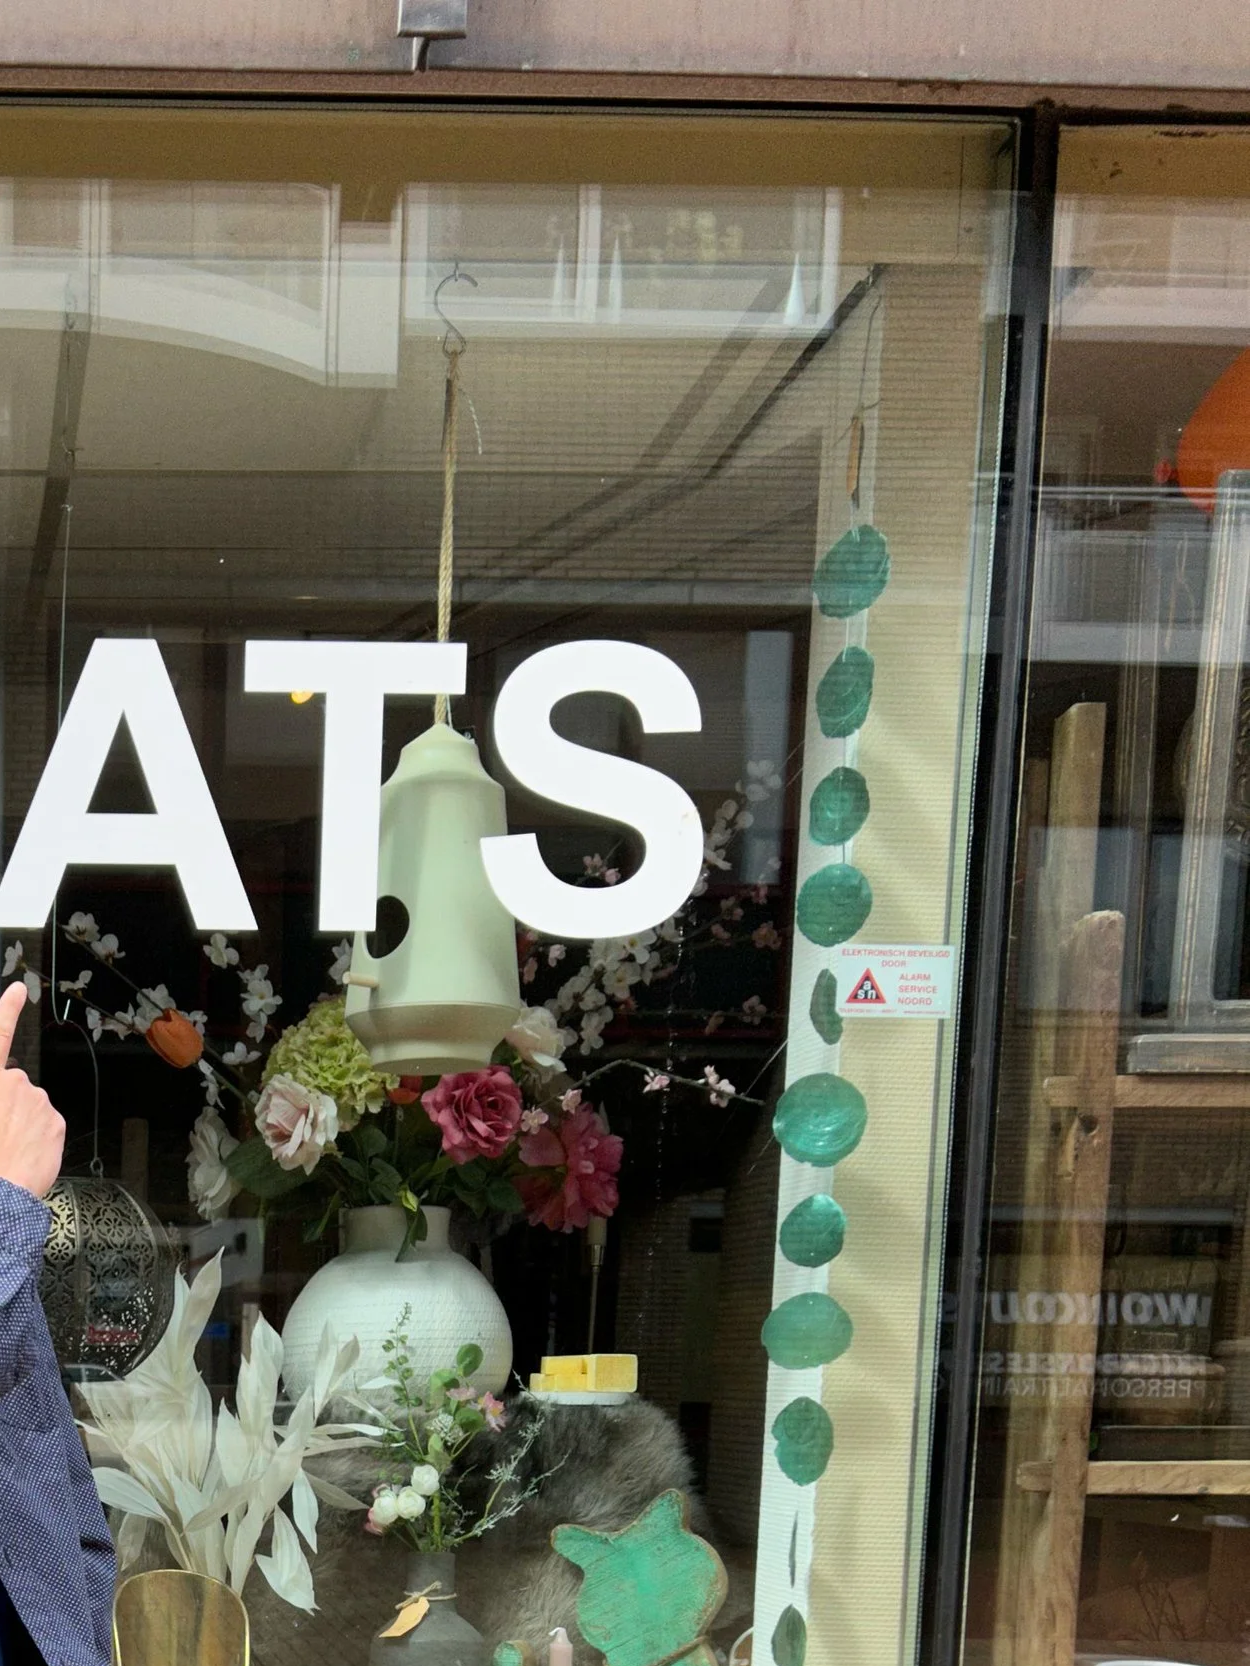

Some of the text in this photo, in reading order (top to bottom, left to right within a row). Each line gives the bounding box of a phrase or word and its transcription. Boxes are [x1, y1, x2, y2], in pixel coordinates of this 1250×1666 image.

[841, 948, 905, 957] ELEKTRONISCH
[881, 960, 907, 968] DOOR
[898, 973, 931, 981] ALARM
[897, 985, 938, 994] SERVICE
[897, 997, 932, 1006] NOORD
